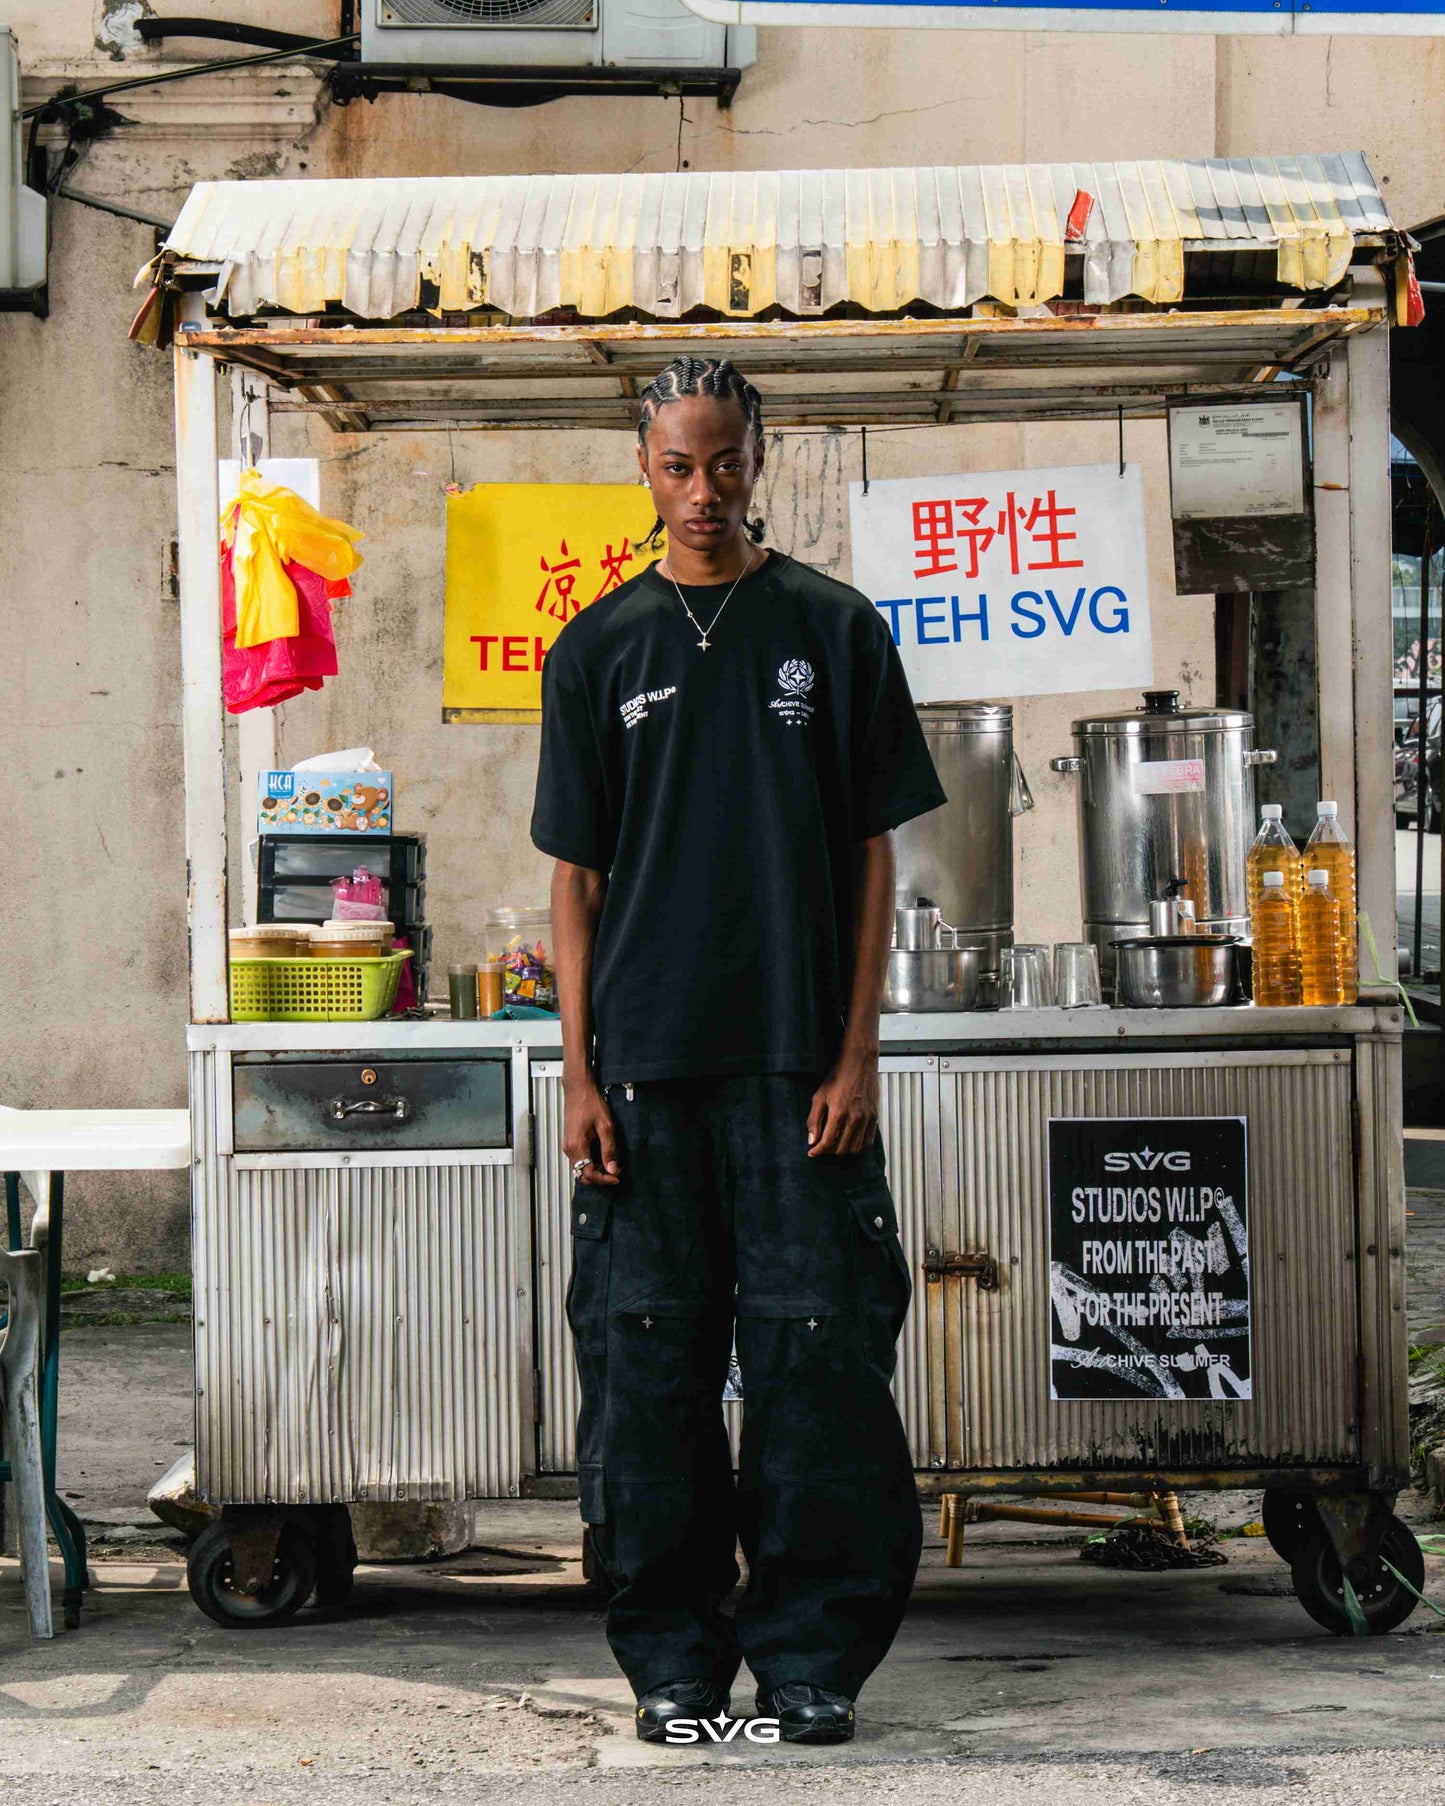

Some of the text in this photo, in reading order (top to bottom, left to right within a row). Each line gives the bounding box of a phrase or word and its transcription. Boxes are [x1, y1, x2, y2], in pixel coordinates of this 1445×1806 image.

[912, 489, 1084, 580] 野性
[875, 586, 1130, 646] TEH SVG
[269, 774, 292, 790] KCA
[1104, 1146, 1191, 1172] SVG
[1071, 1187, 1161, 1223] STUDIOS
[1082, 1240, 1217, 1275] FROM THE PAST
[1076, 1292, 1223, 1326] FOR THE PRESENT
